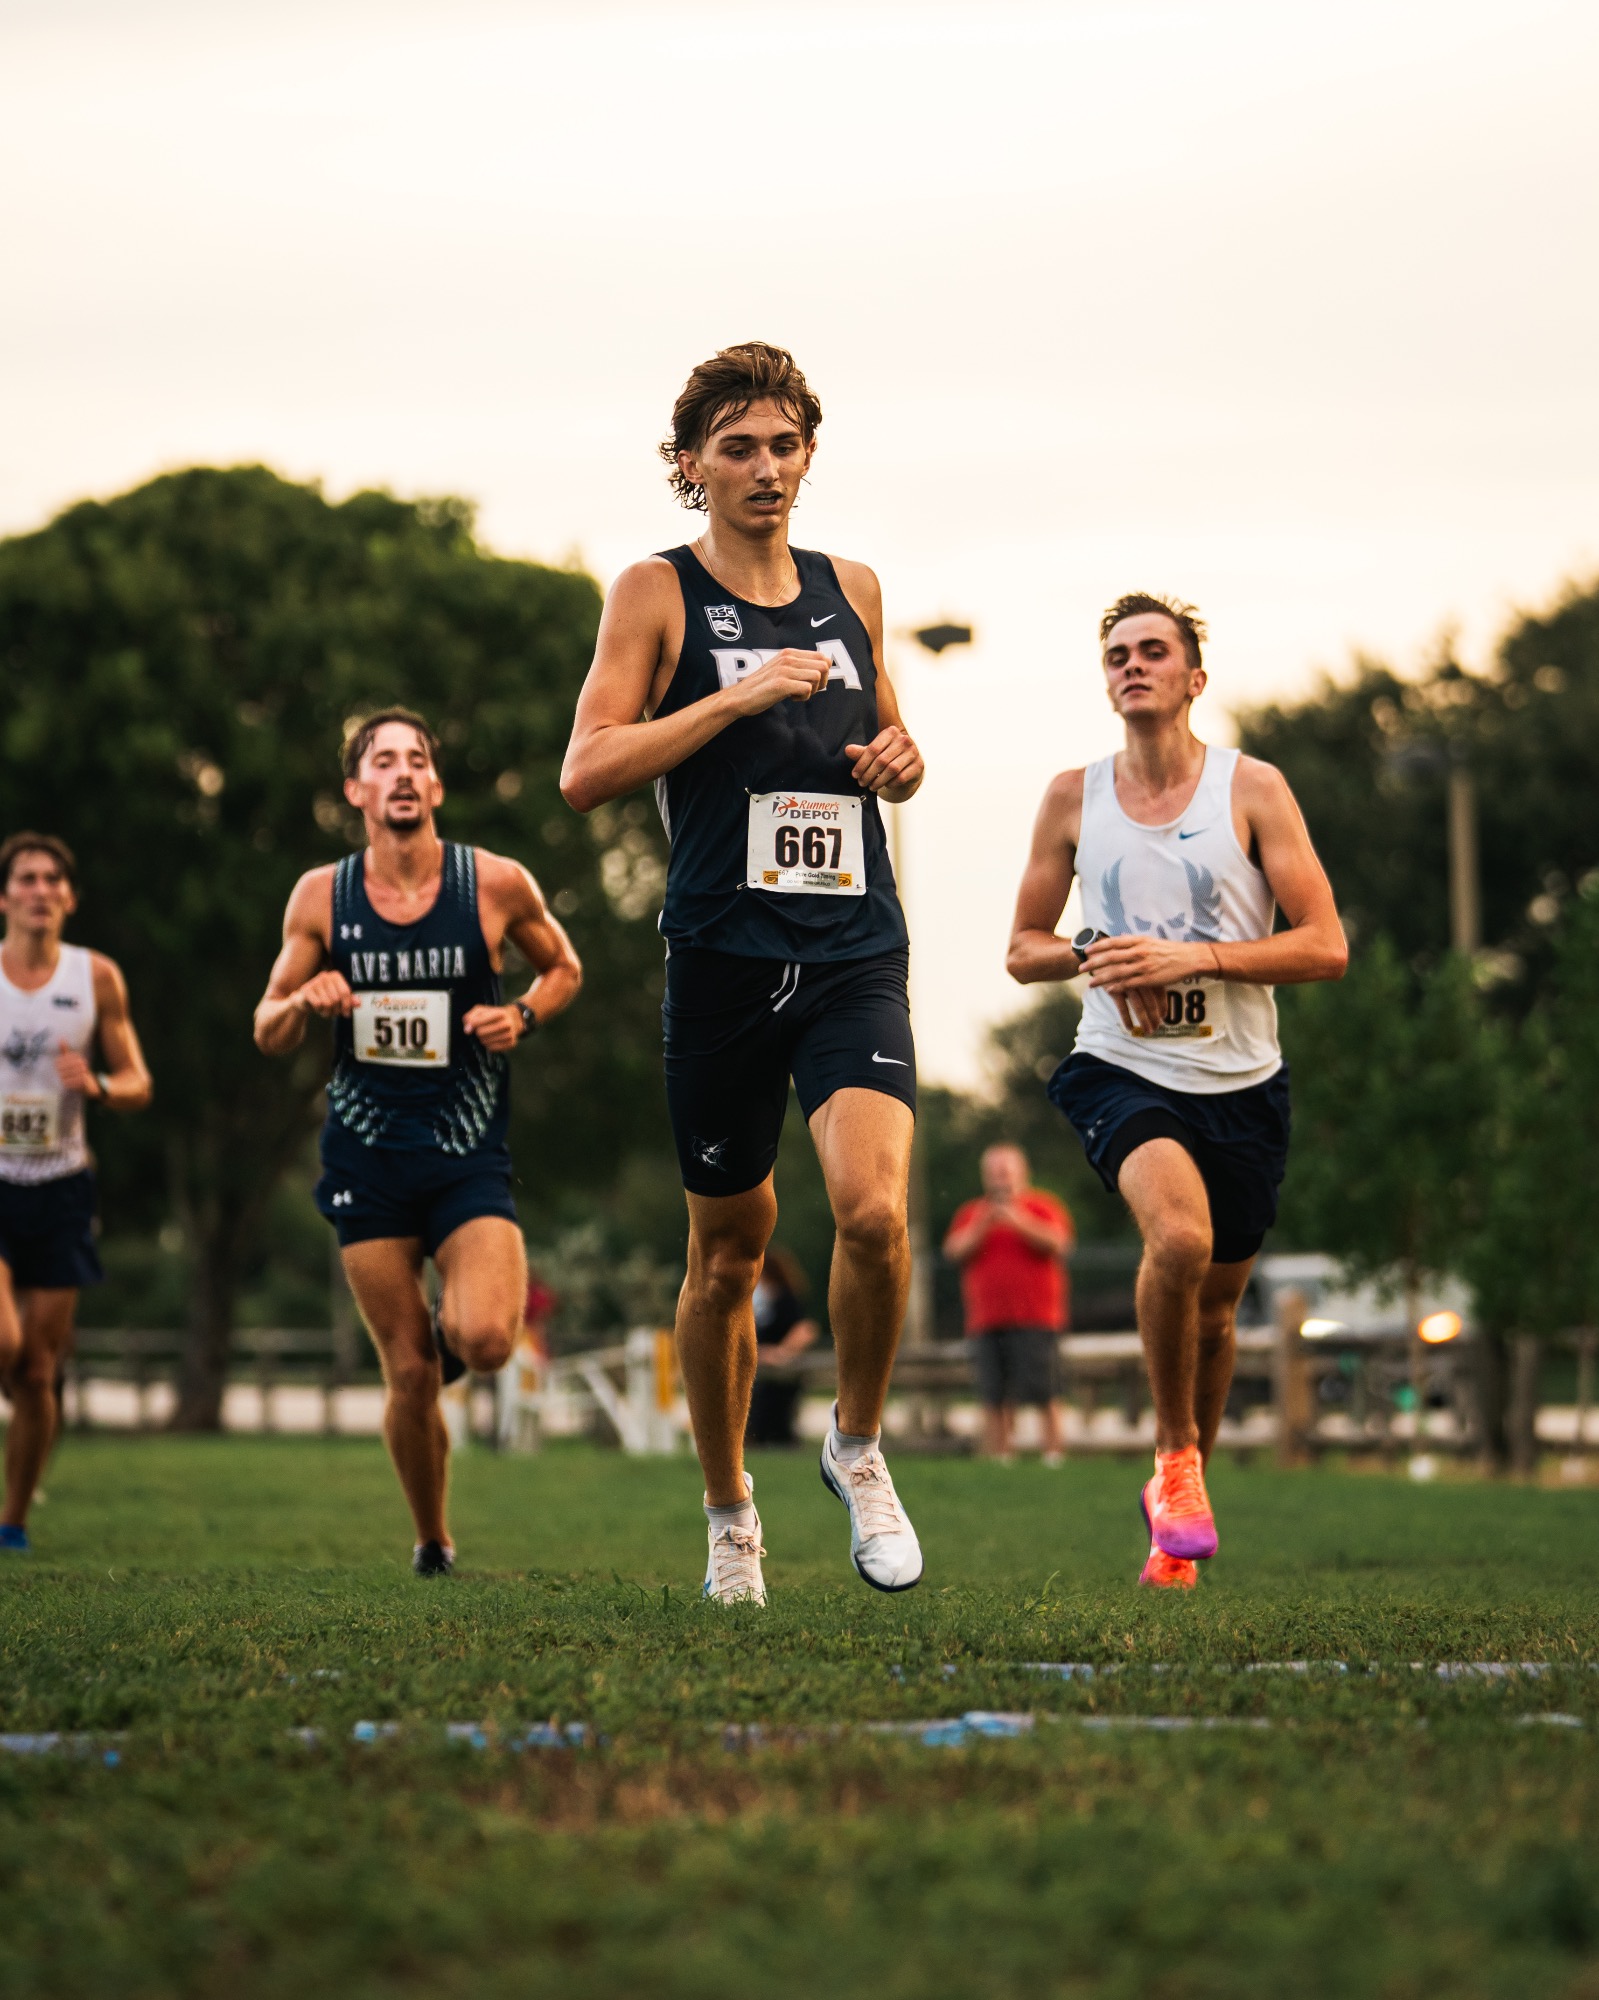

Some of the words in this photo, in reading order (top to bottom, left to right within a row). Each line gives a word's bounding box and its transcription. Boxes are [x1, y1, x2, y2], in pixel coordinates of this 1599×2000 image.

[709, 608, 734, 617] SSC
[709, 638, 862, 693] PA
[790, 809, 840, 821] DEPOT
[799, 800, 840, 811] Runner's
[775, 825, 842, 869] 667
[351, 951, 390, 982] AVE
[396, 946, 466, 980] MARIA
[1162, 988, 1206, 1026] 08
[374, 1016, 428, 1048] 510
